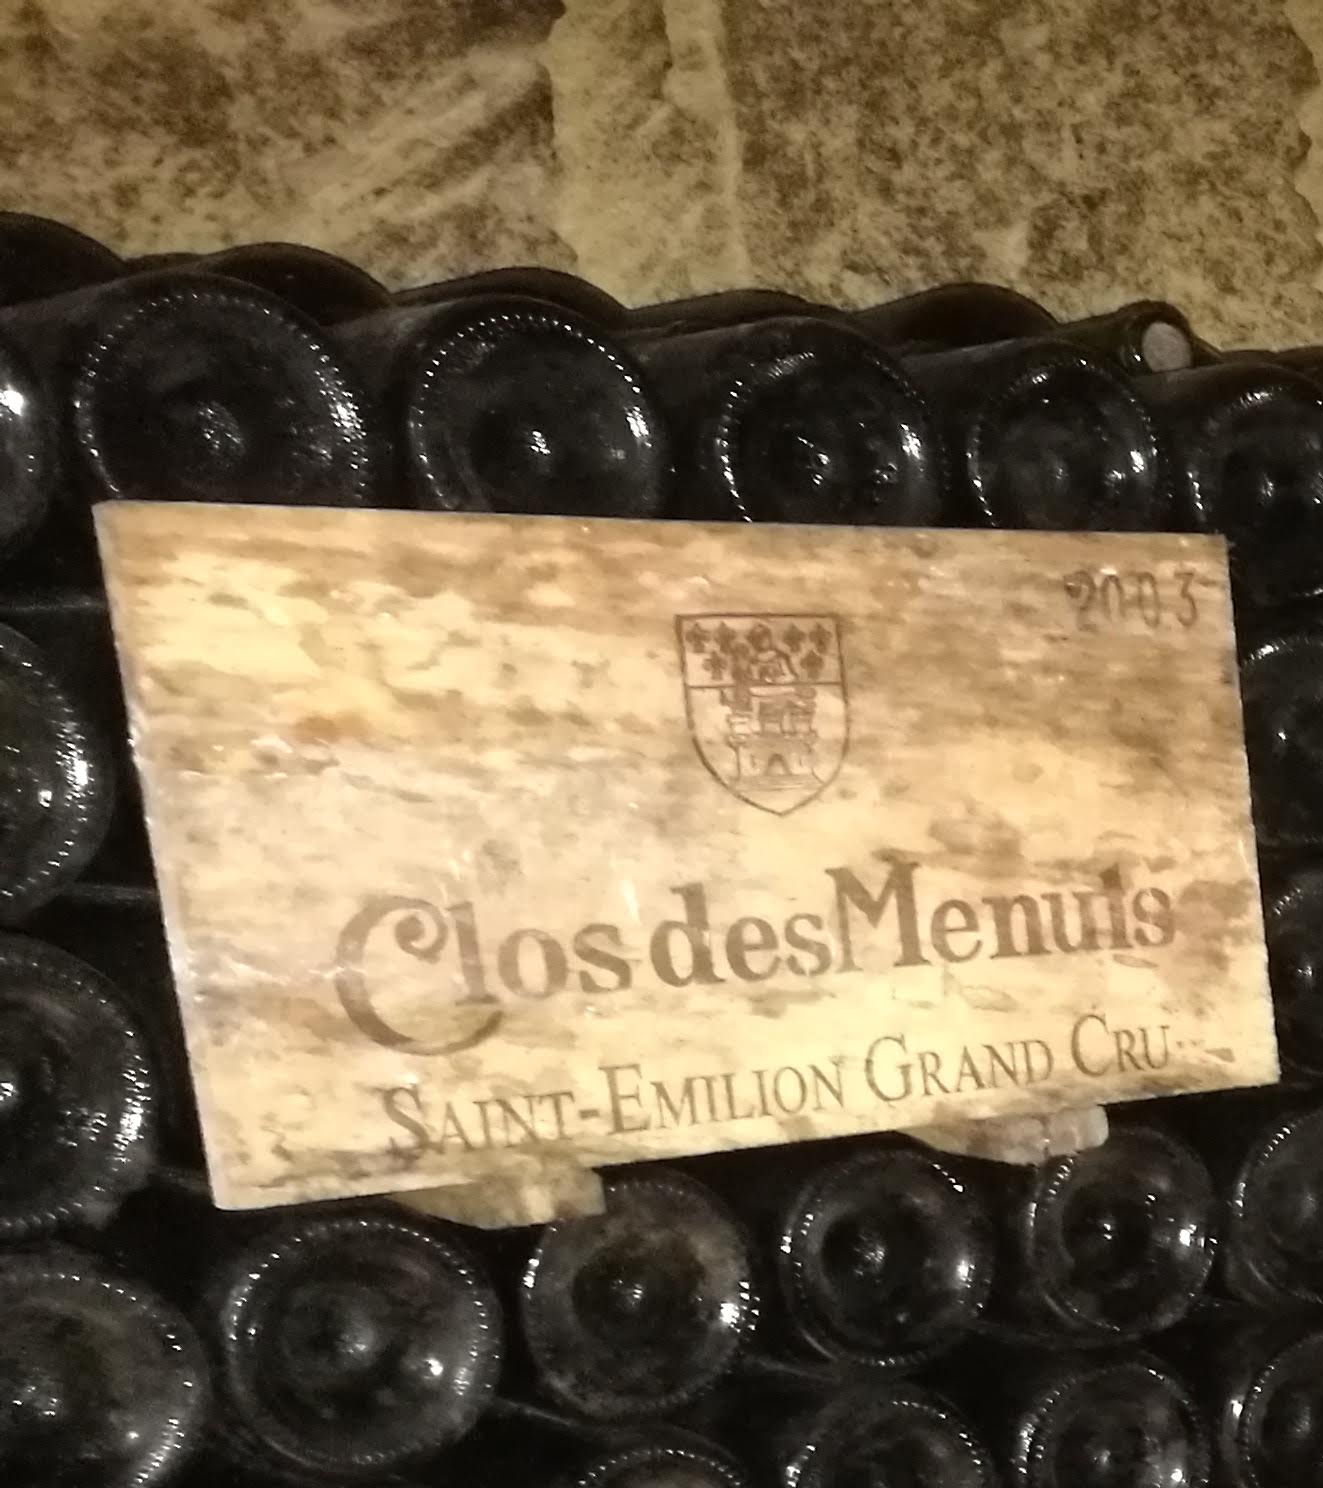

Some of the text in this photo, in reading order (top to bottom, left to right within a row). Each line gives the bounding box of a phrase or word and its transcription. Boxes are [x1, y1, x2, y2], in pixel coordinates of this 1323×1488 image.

[650, 881, 834, 989] des
[864, 1033, 1055, 1103] GRAND
[1070, 1014, 1171, 1078] CRU
